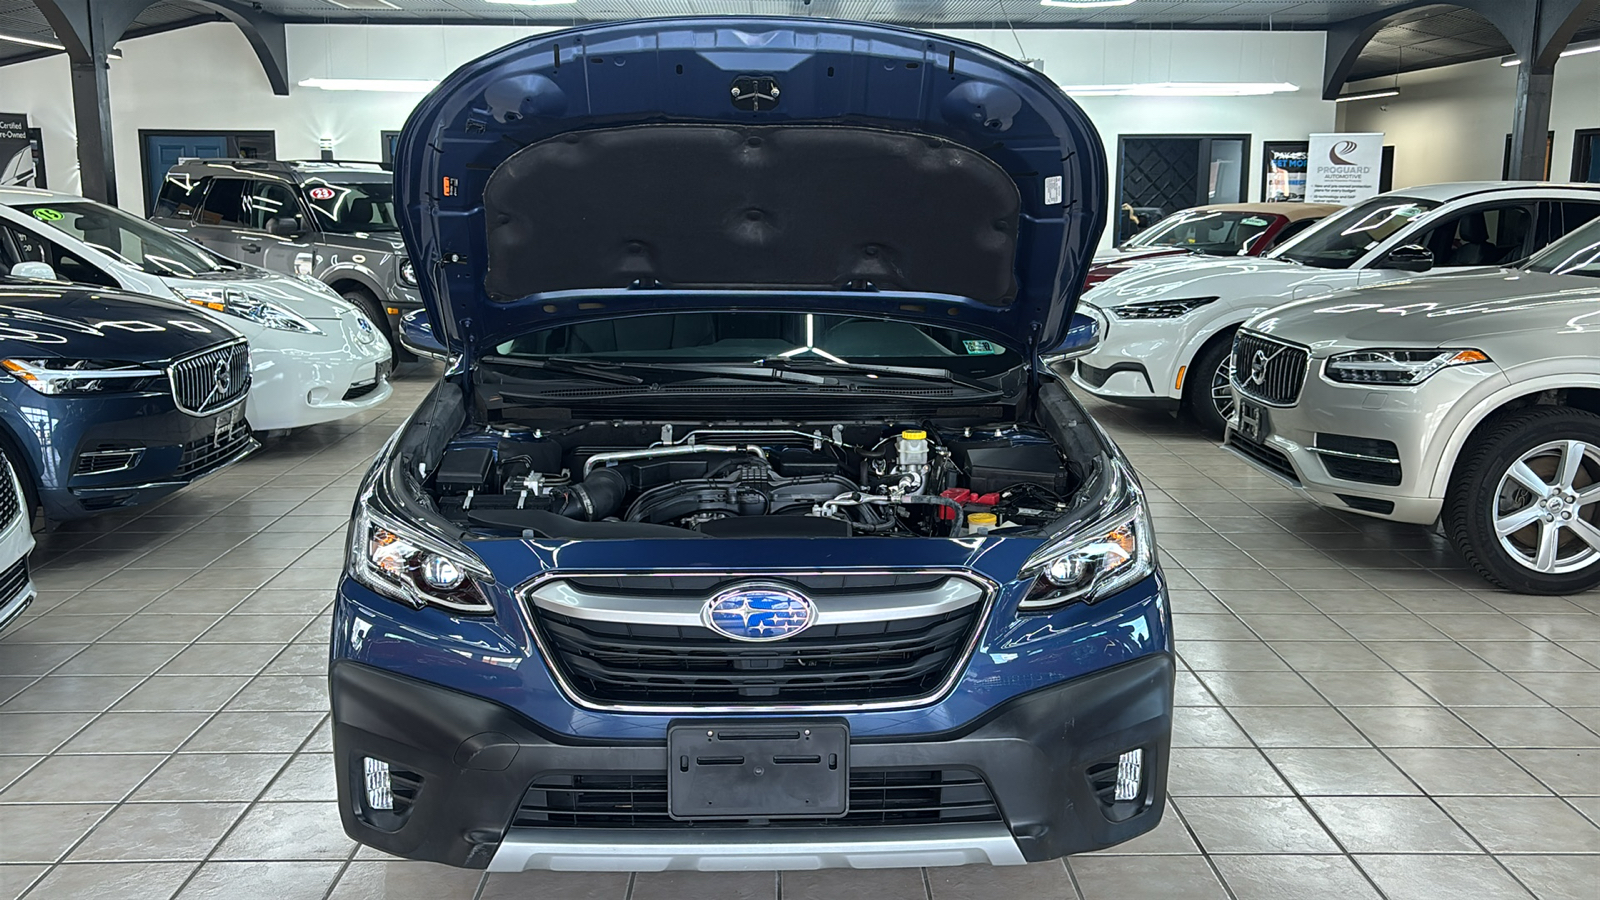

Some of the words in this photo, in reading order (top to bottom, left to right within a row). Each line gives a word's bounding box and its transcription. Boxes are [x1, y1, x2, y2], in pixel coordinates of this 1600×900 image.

[0, 121, 22, 130] Certified
[0, 130, 27, 139] re-Owned
[1271, 159, 1288, 168] GET
[1317, 166, 1370, 174] PROGUARD
